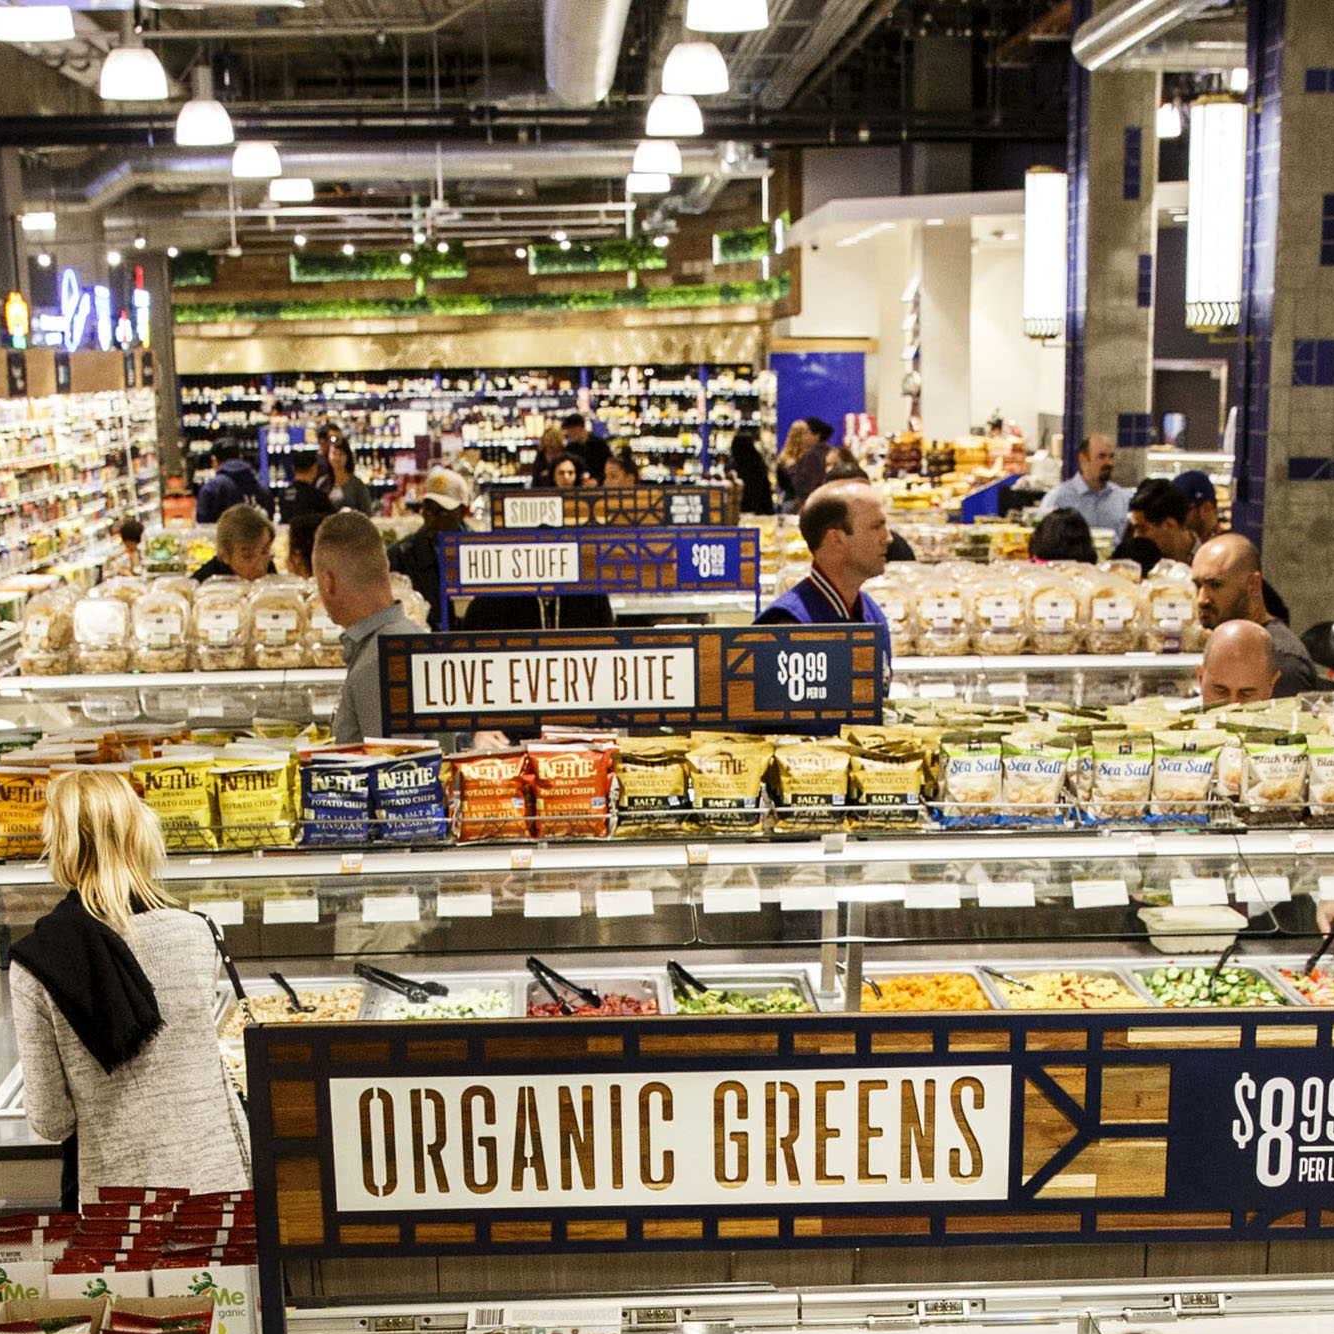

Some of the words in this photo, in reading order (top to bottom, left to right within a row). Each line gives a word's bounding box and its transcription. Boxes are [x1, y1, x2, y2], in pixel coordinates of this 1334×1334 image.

[509, 498, 557, 523] SOUPS
[468, 548, 502, 579] HOT
[512, 546, 570, 578] STUFF
[424, 657, 495, 707] LOVE
[510, 655, 598, 705] EVERY
[613, 653, 676, 702] BITE
[461, 758, 518, 780] KETTLE
[538, 757, 597, 780] KETTLE
[1007, 757, 1032, 773] Sea
[1035, 758, 1062, 775] Salt
[1098, 762, 1122, 777] Sea
[1157, 757, 1183, 774] Sea
[1186, 758, 1214, 775] Salt
[146, 770, 202, 791] KETTLE
[220, 770, 278, 793] KETTLE
[311, 771, 368, 793] KETTLE
[378, 766, 437, 791] KETTLE
[311, 798, 342, 808] POTATO
[708, 799, 729, 808] SALT
[871, 794, 892, 804] SALT
[357, 1080, 677, 1197] ORGANIC
[712, 1075, 987, 1188] GREENS
[1298, 1157, 1326, 1182] PER
